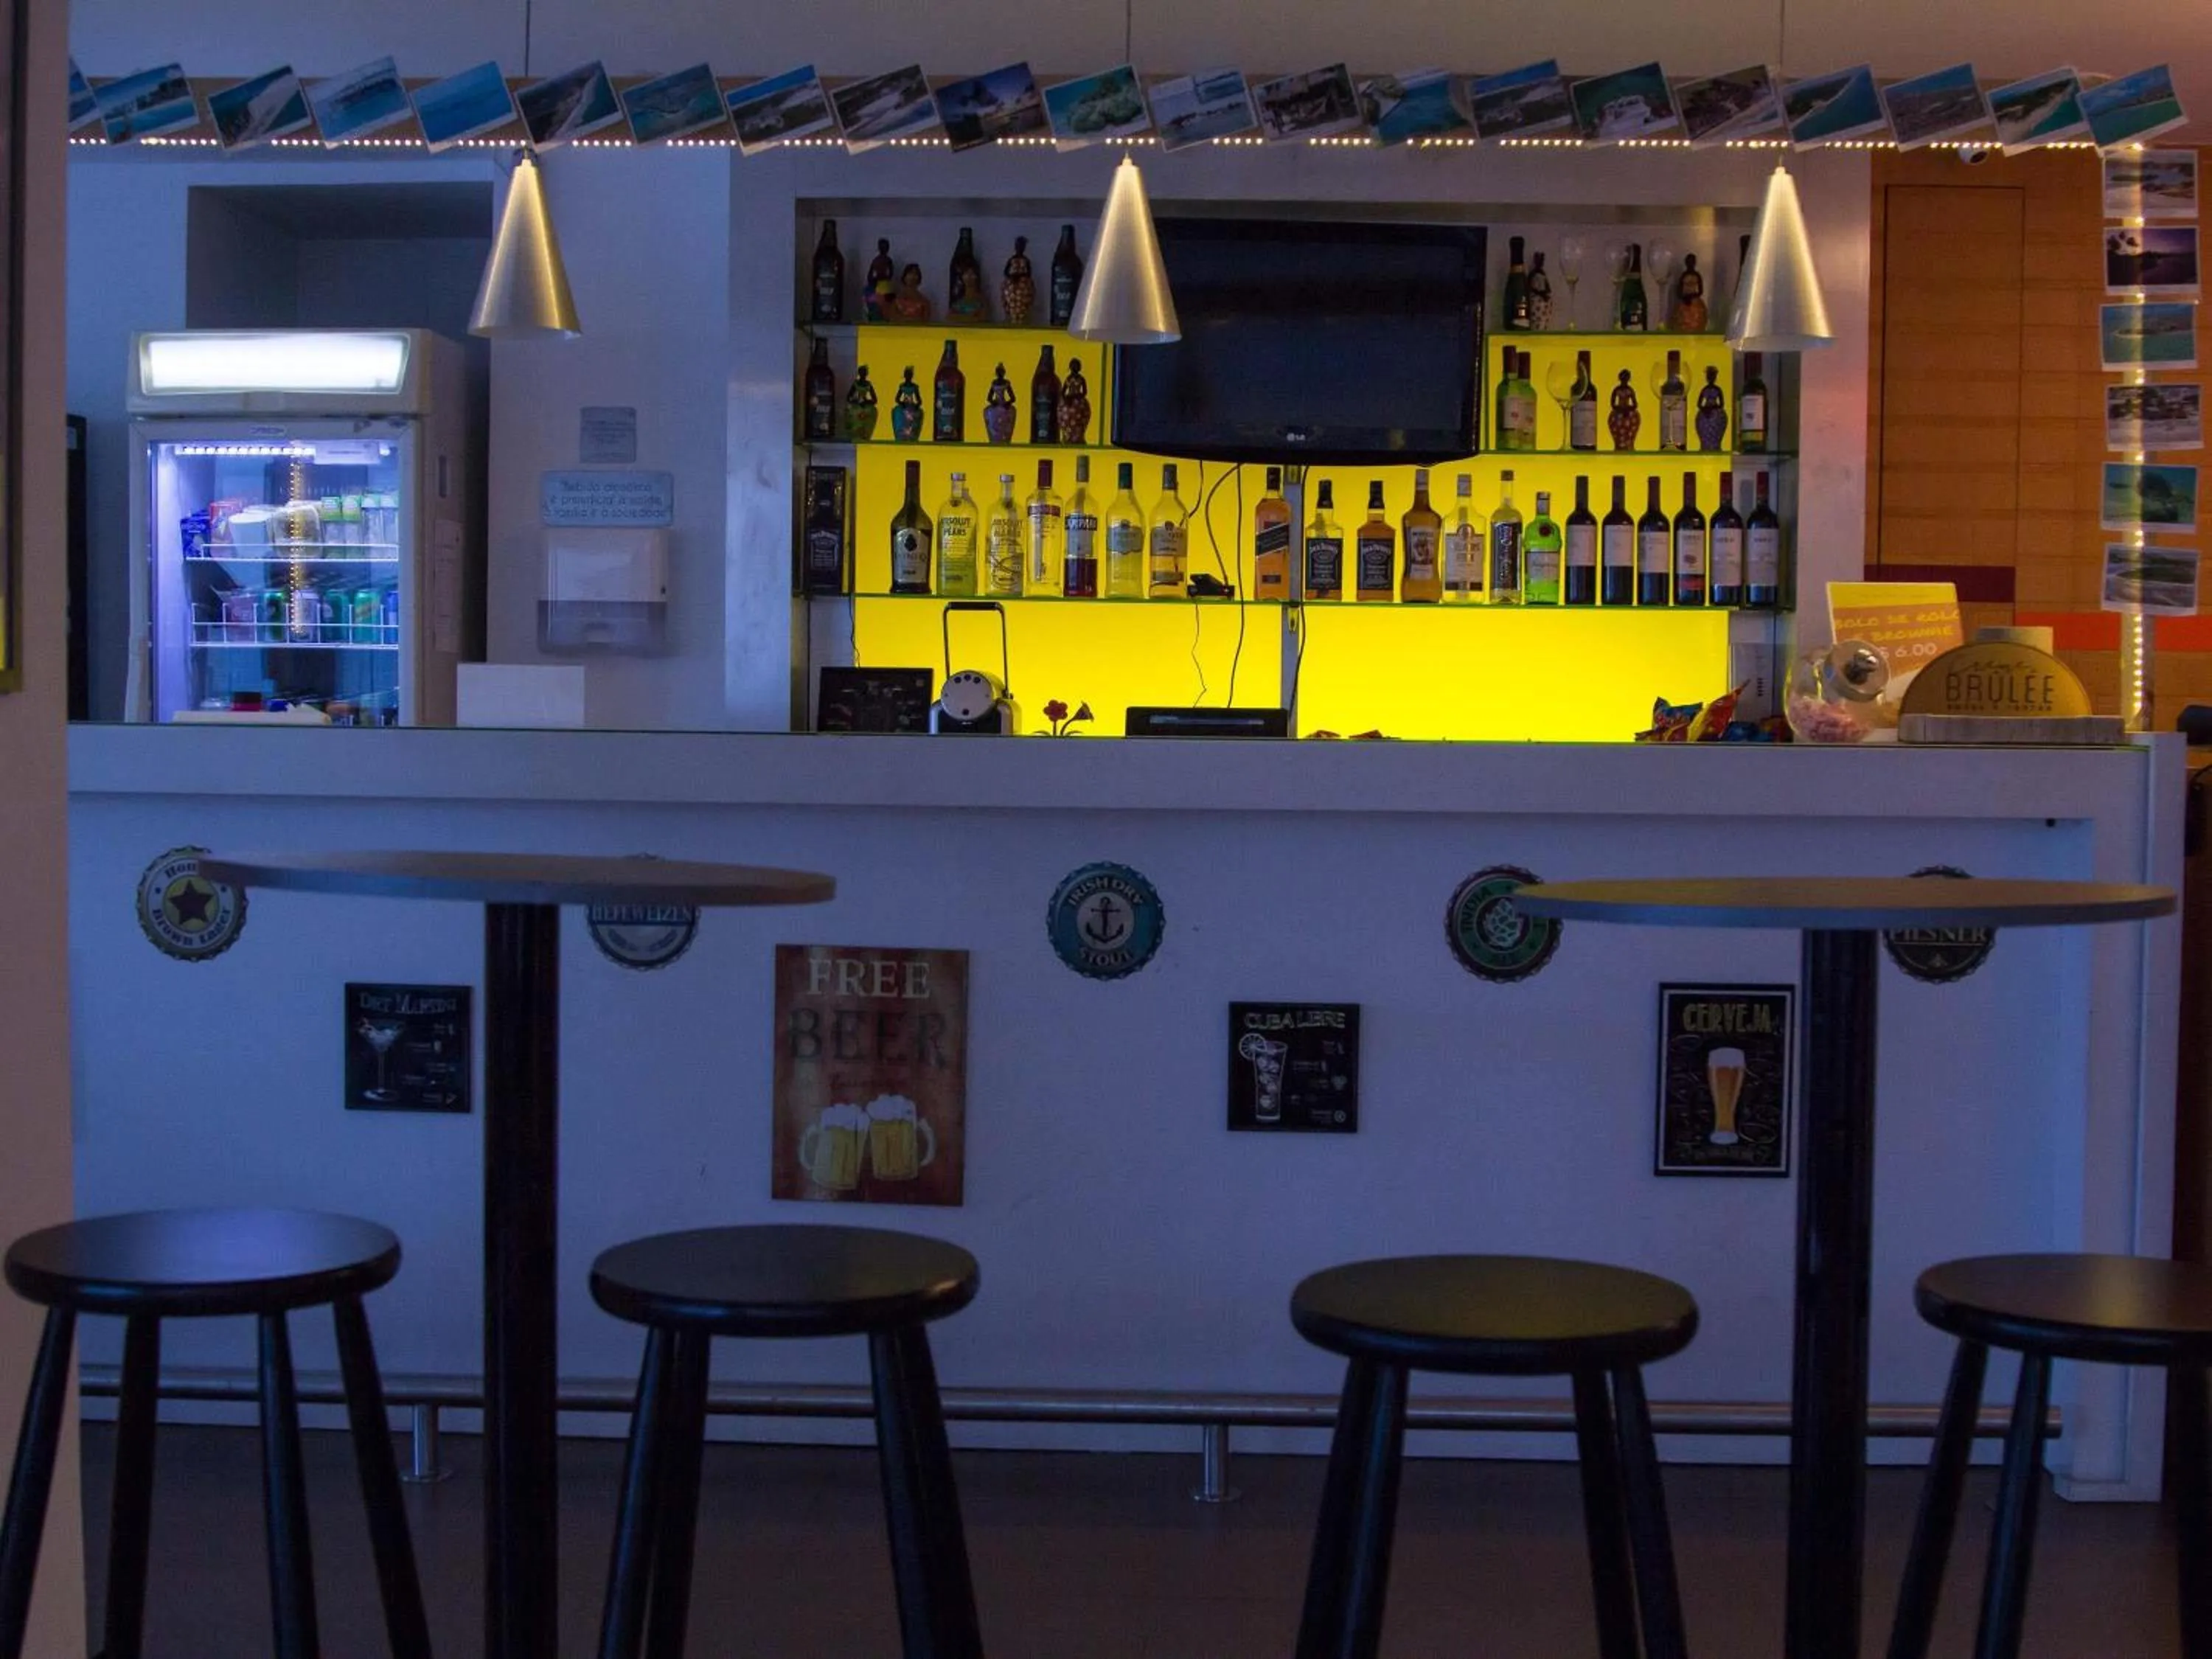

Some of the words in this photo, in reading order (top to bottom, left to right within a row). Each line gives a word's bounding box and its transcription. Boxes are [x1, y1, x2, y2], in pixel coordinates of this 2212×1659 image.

[1067, 877, 1108, 906] IRISH
[1111, 878, 1144, 905] DRY
[153, 908, 193, 945] Brown
[199, 907, 231, 944] Lager
[1461, 886, 1492, 933] INDIA
[1079, 947, 1133, 967] STOUT
[806, 958, 931, 999] FREE
[1244, 1012, 1295, 1031] CUBA
[1683, 1001, 1772, 1033] CERVEJA
[787, 1006, 947, 1069] BEER
